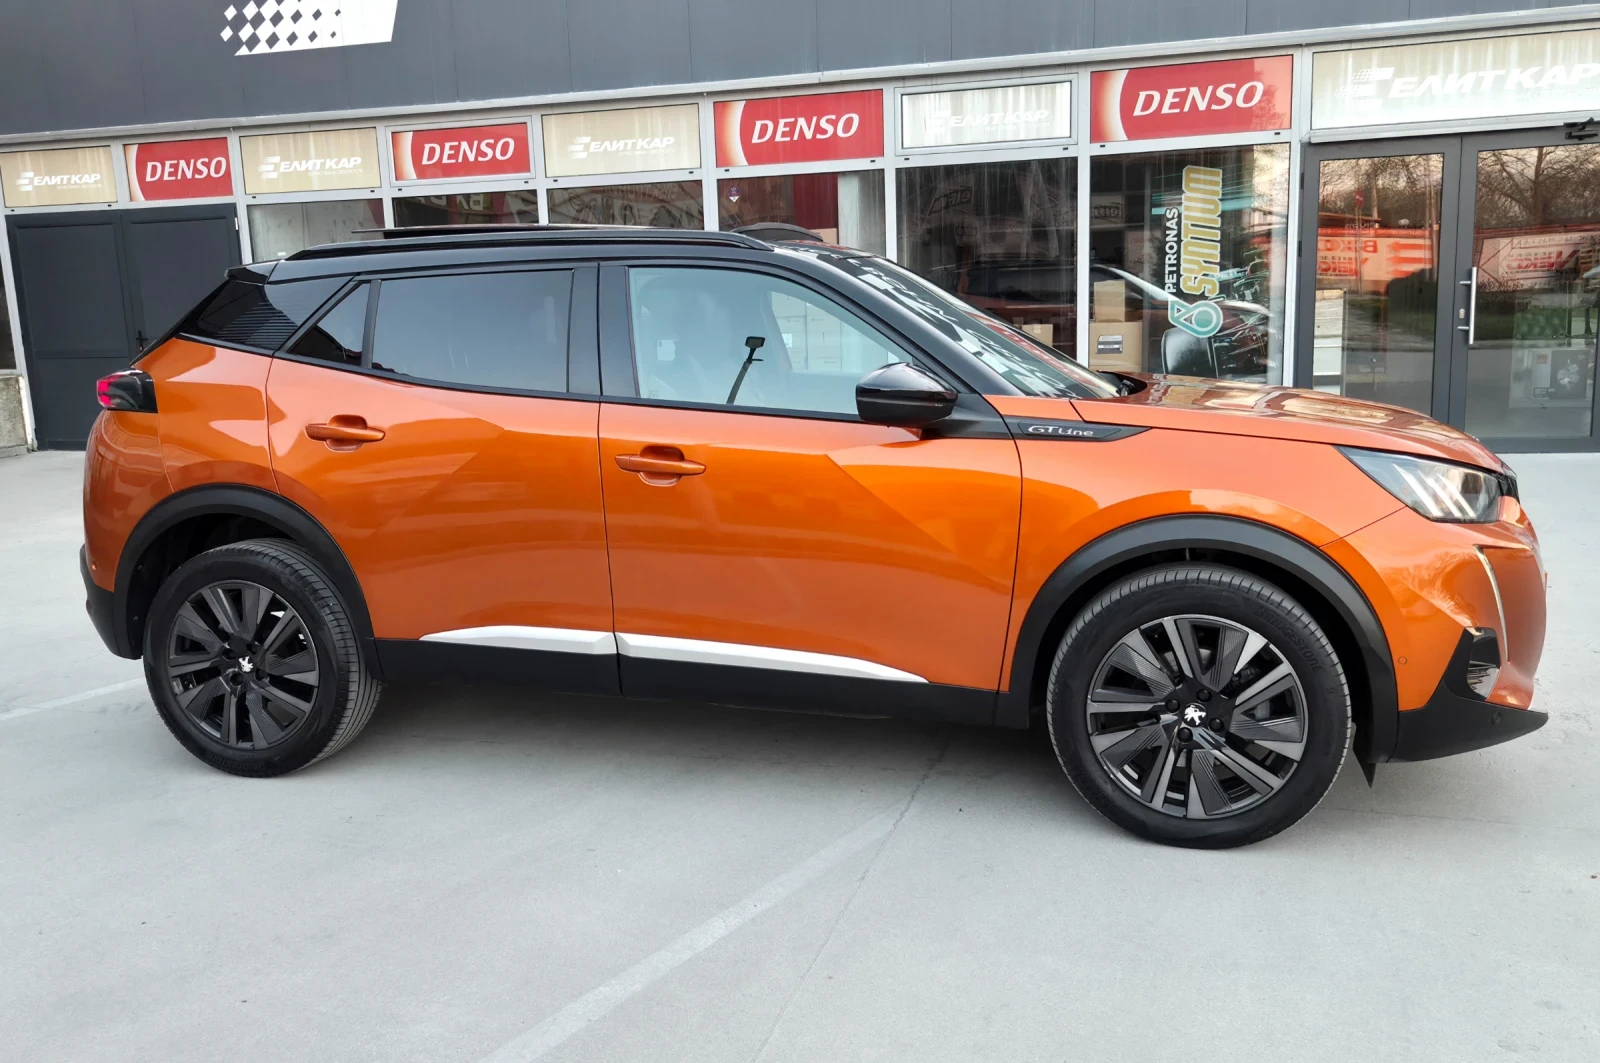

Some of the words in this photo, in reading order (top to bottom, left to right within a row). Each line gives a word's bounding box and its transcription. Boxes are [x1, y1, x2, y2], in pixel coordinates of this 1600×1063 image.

[1132, 81, 1265, 117] DENSO
[751, 112, 860, 144] DENSO
[421, 137, 515, 165] DENSO
[145, 156, 227, 182] DENSO
[1180, 164, 1223, 298] SYNTIUM
[1164, 206, 1179, 293] PETRONAS
